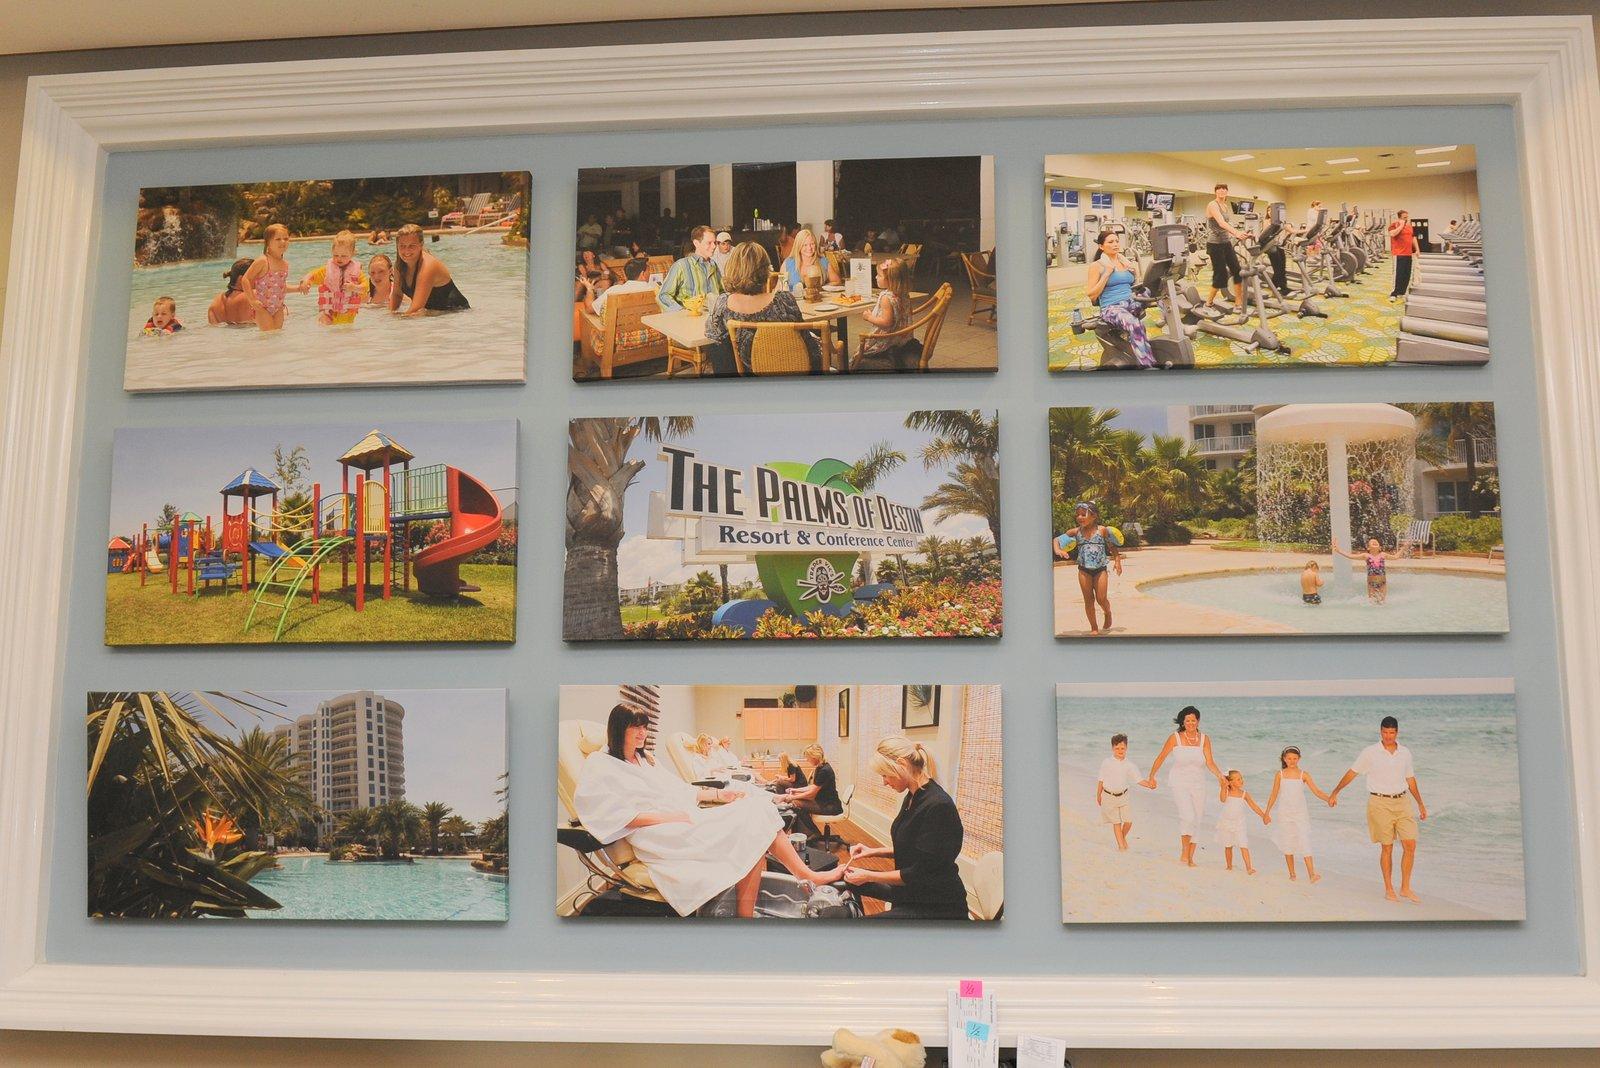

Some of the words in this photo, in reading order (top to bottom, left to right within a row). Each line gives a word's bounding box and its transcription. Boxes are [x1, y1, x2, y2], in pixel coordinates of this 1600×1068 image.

[662, 446, 744, 516] THE
[756, 466, 849, 526] PALMS
[853, 496, 875, 529] OF
[877, 495, 924, 534] DESTIN
[719, 525, 790, 545] Resort
[796, 530, 811, 545] &
[815, 531, 885, 547] Conference
[886, 536, 914, 548] Center
